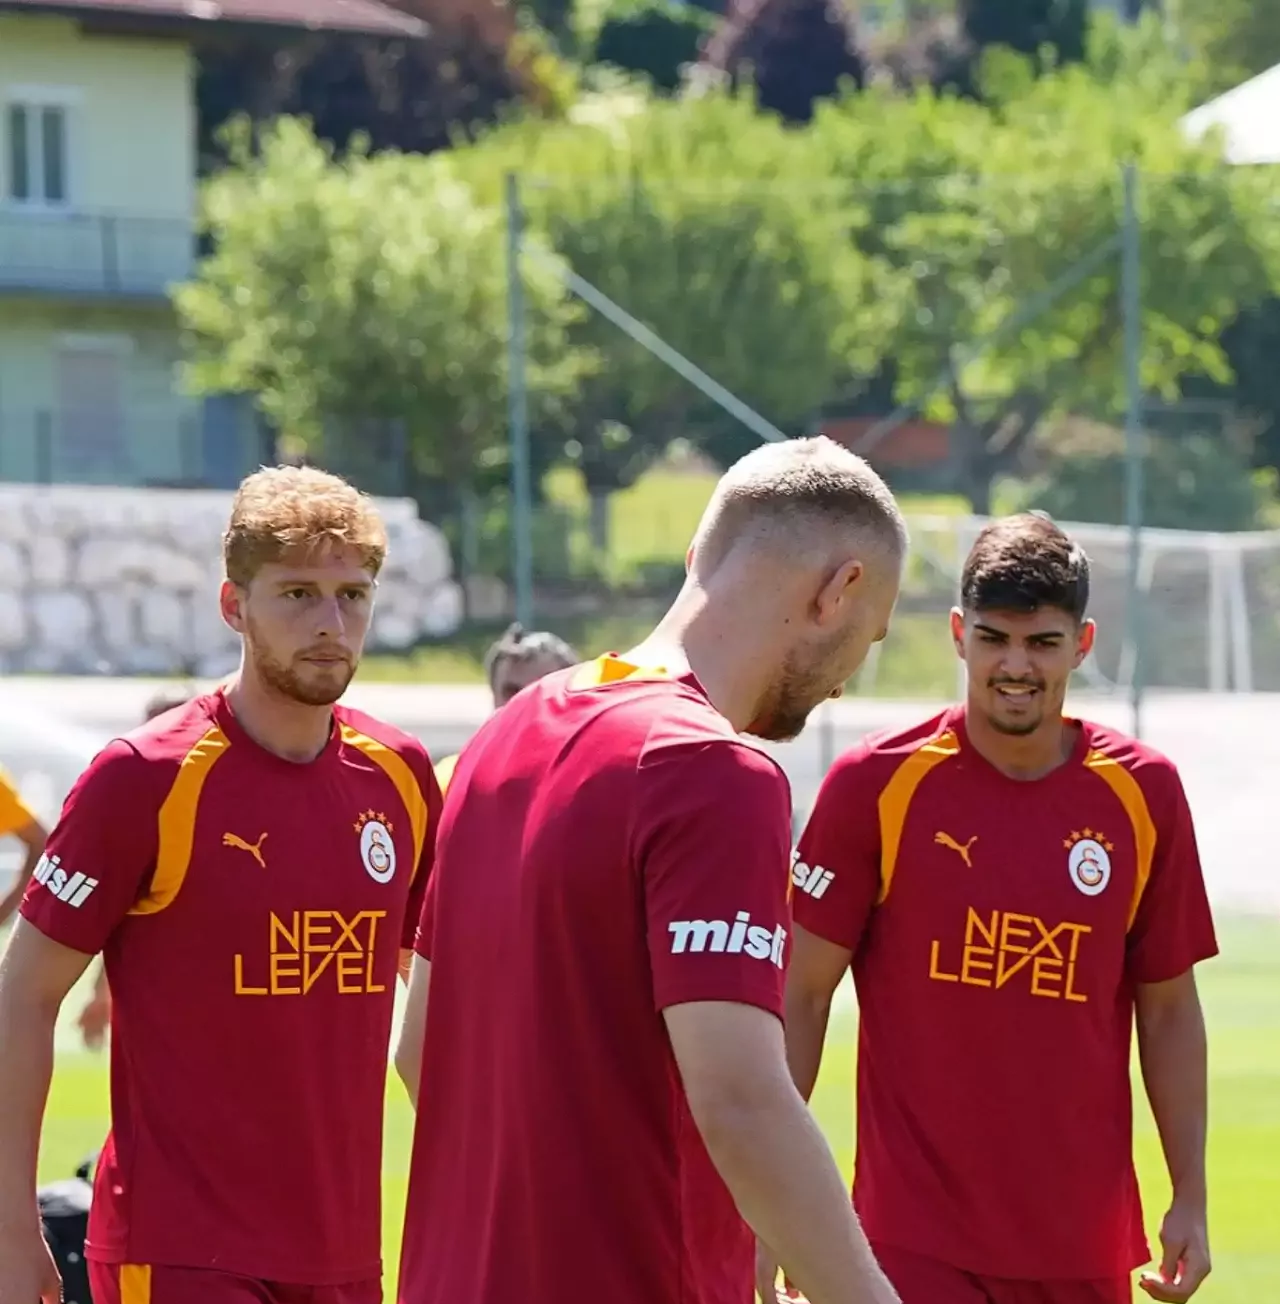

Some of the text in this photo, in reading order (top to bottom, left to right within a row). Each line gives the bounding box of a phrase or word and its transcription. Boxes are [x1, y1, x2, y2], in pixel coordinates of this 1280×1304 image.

[270, 910, 387, 953] NEXT
[668, 911, 788, 969] misli
[964, 906, 1093, 961] NEXT
[234, 951, 386, 995] LEVEL
[929, 940, 1088, 1002] LEVEL
